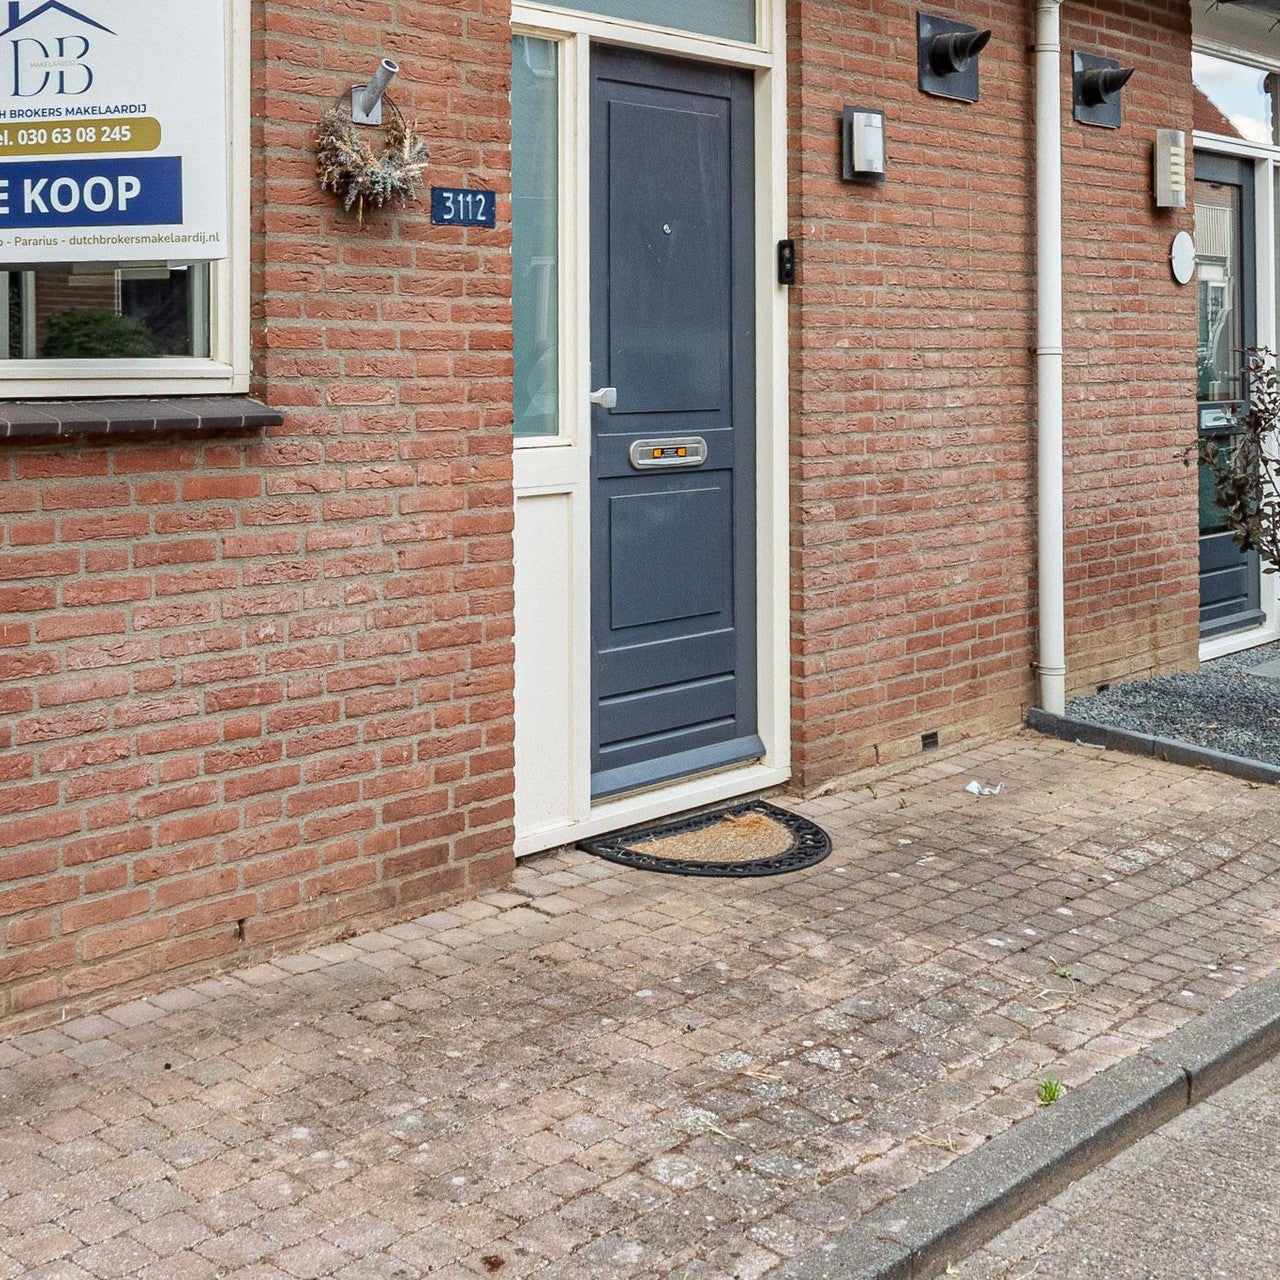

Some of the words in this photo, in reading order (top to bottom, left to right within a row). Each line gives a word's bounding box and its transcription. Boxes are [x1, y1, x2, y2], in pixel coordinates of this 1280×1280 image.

[10, 35, 94, 97] DB
[10, 107, 62, 119] BROKERS
[65, 104, 147, 117] MAKELAARDIJ
[18, 129, 47, 145] 030
[51, 128, 72, 144] 63
[76, 127, 96, 143] 08
[100, 125, 131, 142] 245
[23, 175, 141, 214] KOOP
[442, 192, 487, 221] 3112
[14, 236, 59, 246] Pararius
[69, 232, 220, 245] dutchbrokersmakelaardij.nl
